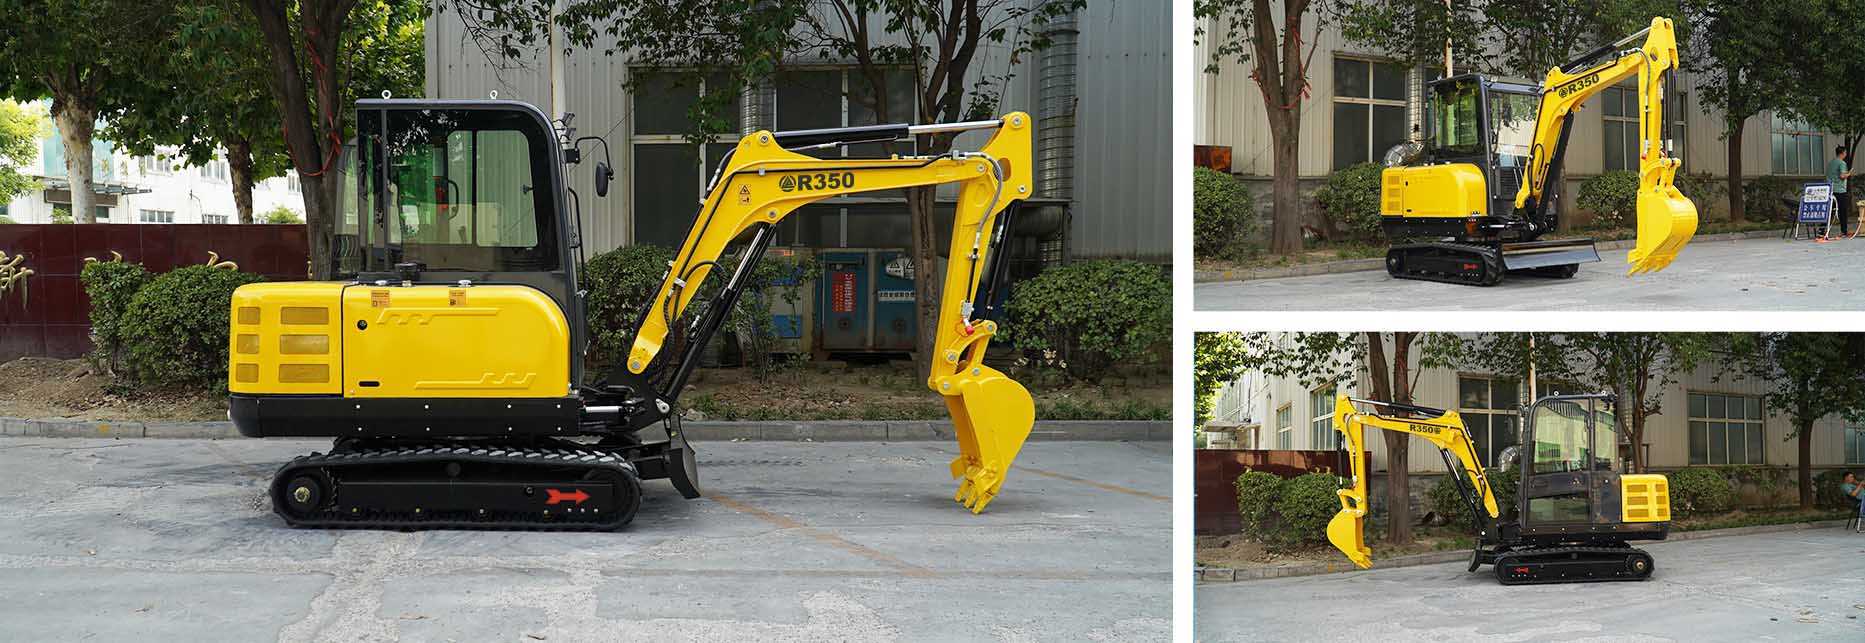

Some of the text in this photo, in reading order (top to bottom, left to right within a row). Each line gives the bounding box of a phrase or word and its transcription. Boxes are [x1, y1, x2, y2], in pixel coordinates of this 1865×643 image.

[1568, 73, 1600, 95] R350
[797, 171, 855, 191] R350
[1409, 424, 1434, 433] R350
